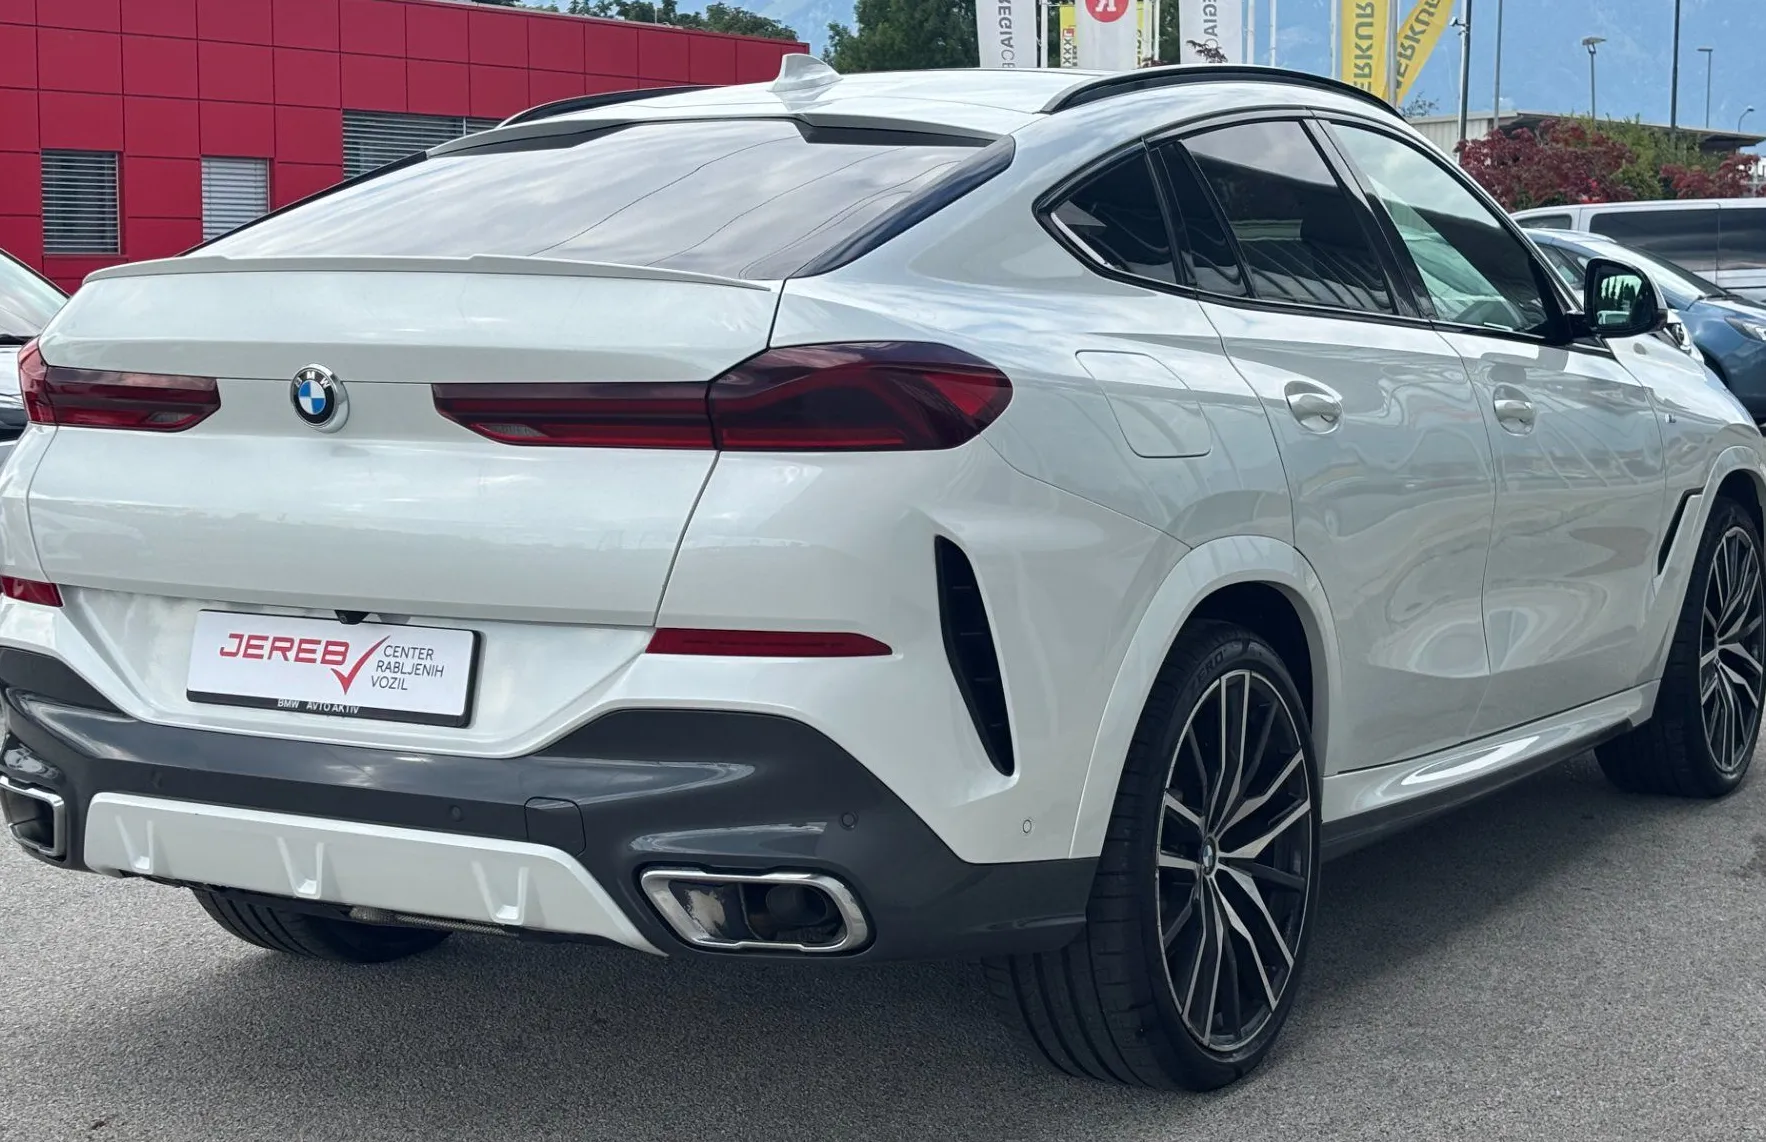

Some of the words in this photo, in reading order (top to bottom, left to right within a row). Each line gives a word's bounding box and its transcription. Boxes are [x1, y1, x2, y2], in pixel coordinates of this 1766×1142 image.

[294, 371, 331, 389] BMW
[219, 633, 350, 666] JEREB
[383, 644, 434, 661] CENTER
[376, 660, 444, 678] RABLJENIH
[371, 675, 408, 691] VOZIL
[277, 699, 299, 709] BMW
[306, 701, 331, 712] AVTO
[331, 704, 359, 714] AKTIV
